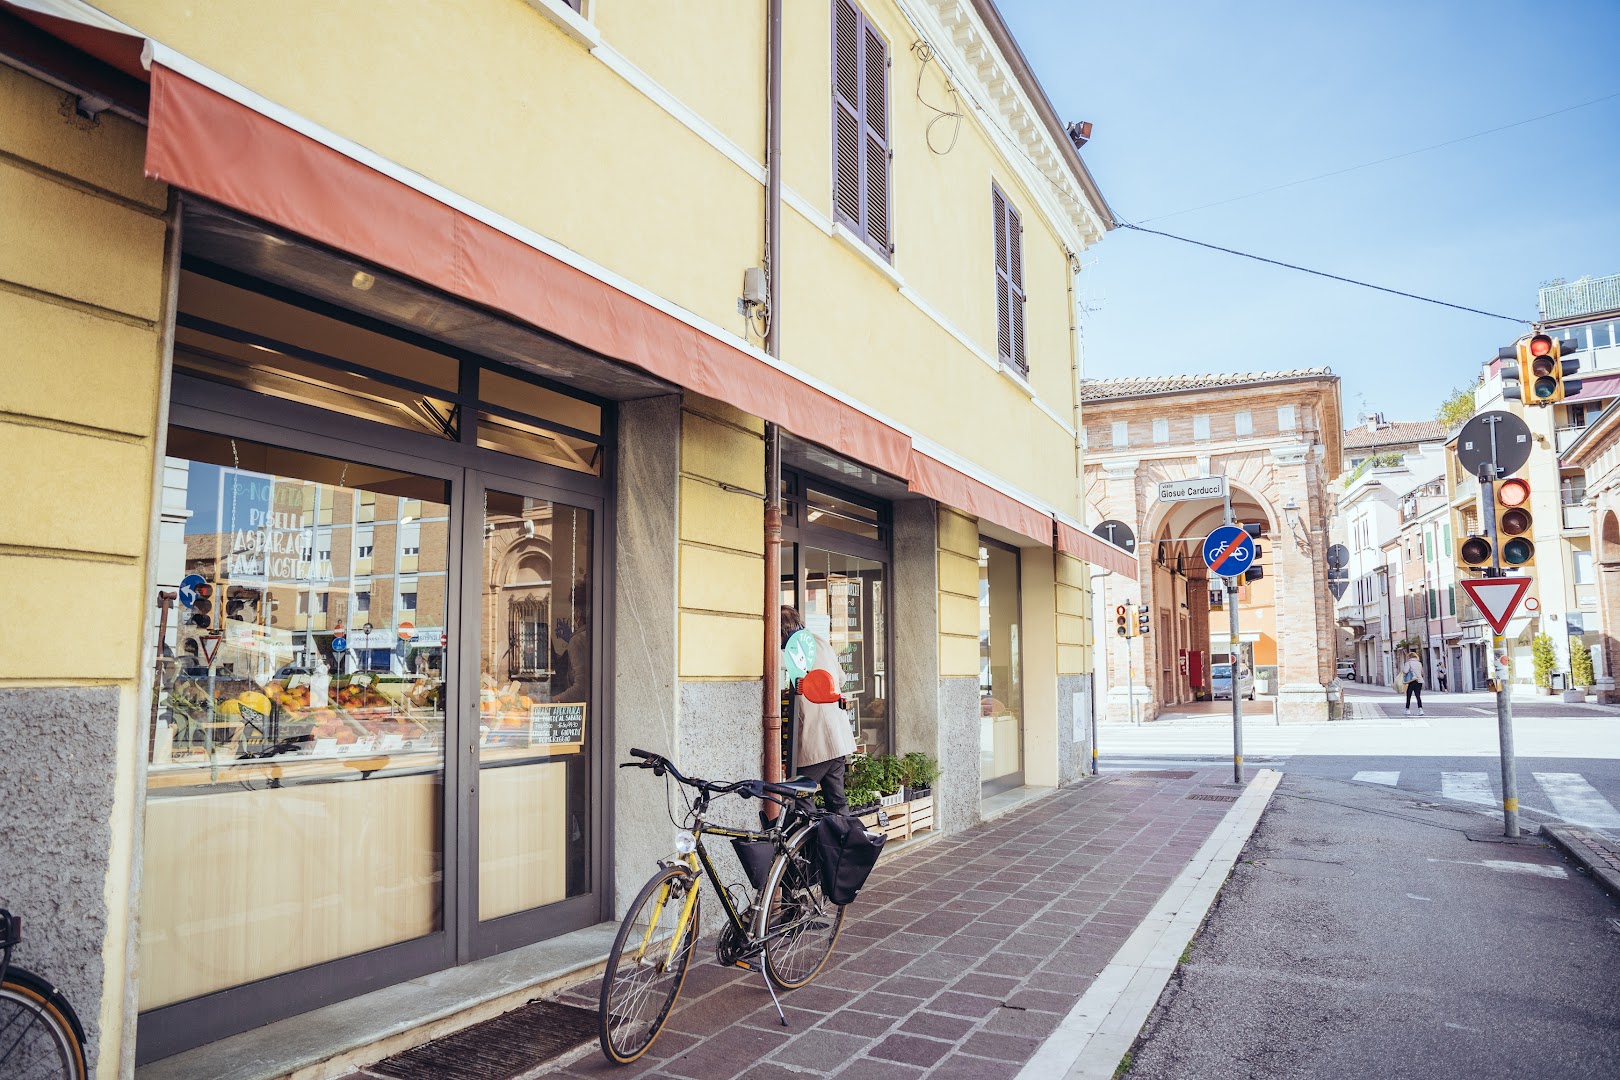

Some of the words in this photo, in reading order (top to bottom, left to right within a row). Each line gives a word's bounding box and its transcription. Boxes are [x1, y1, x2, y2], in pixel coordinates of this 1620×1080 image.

[1161, 488, 1186, 498] Giosuè
[1187, 485, 1220, 496] Carducci
[249, 508, 306, 532] PISELLI
[233, 527, 313, 562] ASPARAGI
[227, 553, 258, 576] FAVA
[265, 557, 335, 583] NOSTRANA
[799, 633, 814, 664] TICKET
[553, 706, 581, 715] APERTURA
[565, 714, 582, 722] SABATO
